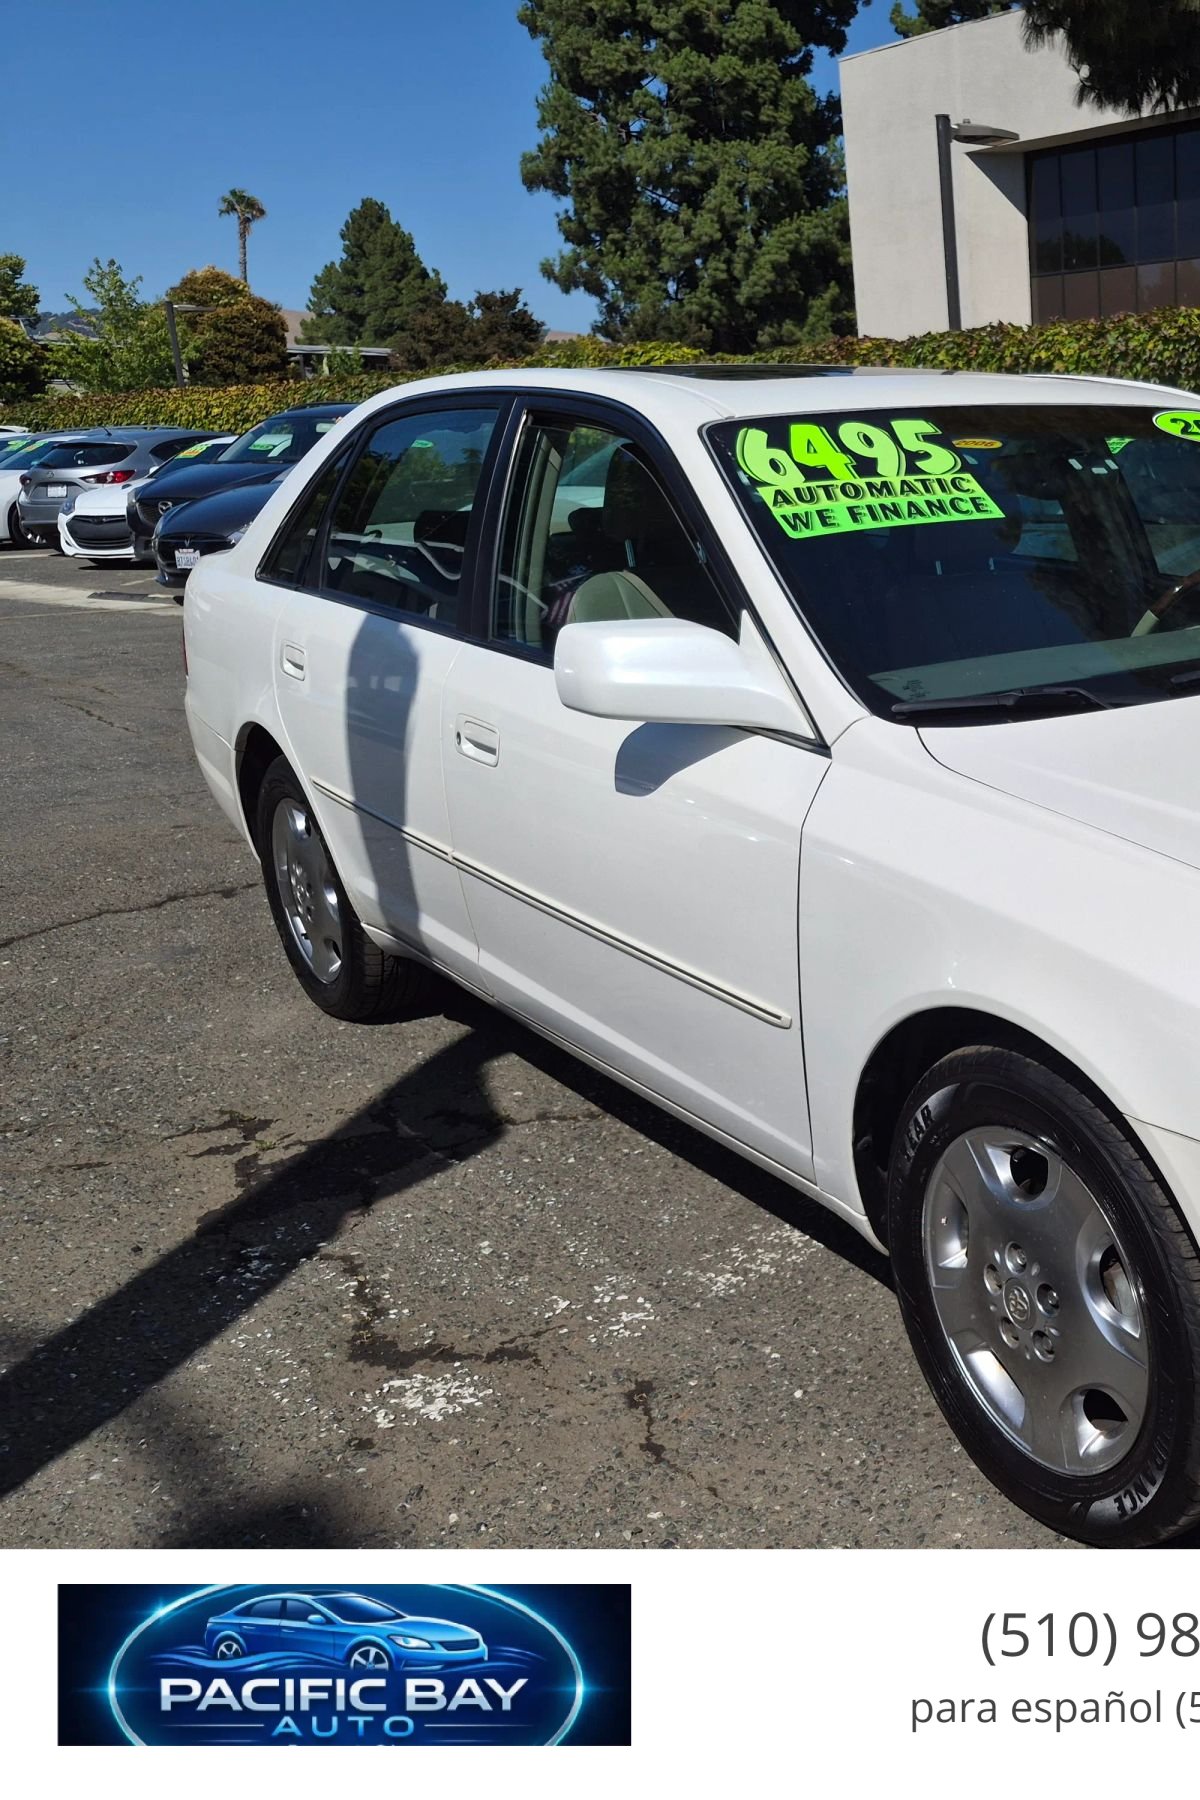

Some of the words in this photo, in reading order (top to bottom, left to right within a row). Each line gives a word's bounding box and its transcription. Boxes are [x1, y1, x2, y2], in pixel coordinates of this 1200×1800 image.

[736, 419, 961, 486] 6495
[772, 476, 973, 508] AUTOMATIC
[780, 510, 839, 532] WE
[846, 496, 990, 526] FINANCE
